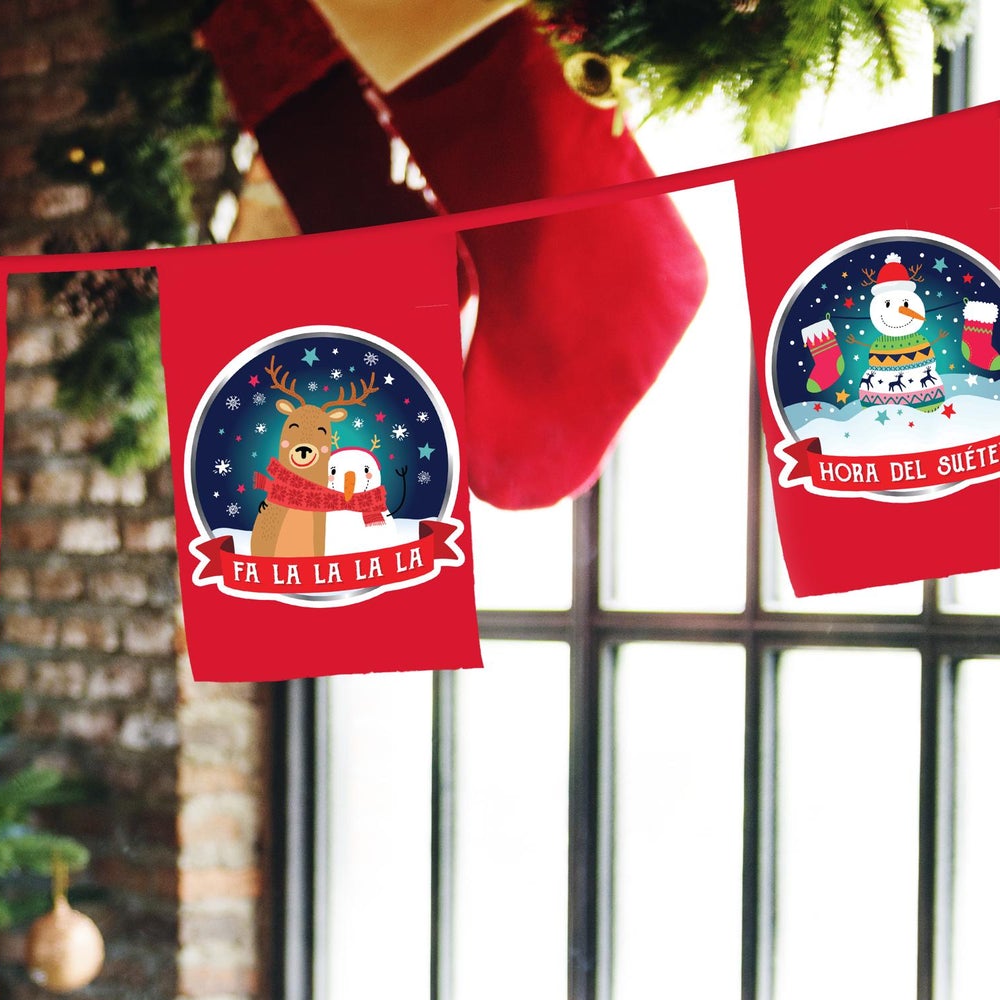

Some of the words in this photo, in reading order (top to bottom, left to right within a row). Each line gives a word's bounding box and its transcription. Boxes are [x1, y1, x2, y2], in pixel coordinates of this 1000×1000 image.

[818, 461, 880, 483] HORA
[889, 459, 927, 482] DEL
[936, 442, 1000, 476] SUÉTE
[232, 560, 261, 584] FA
[272, 563, 302, 585] LA
[313, 562, 343, 584] LA
[354, 556, 384, 581] LA
[394, 547, 424, 573] LA
